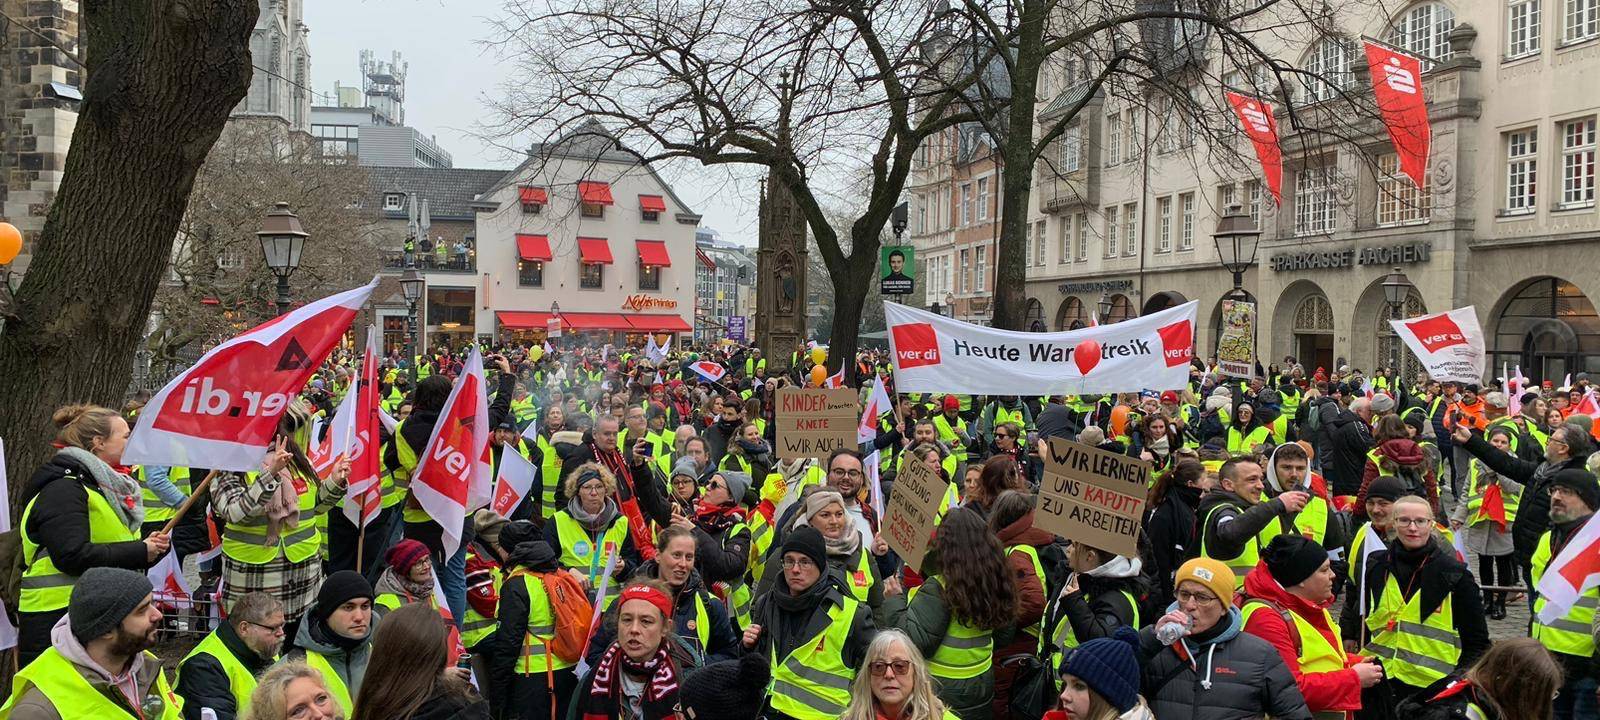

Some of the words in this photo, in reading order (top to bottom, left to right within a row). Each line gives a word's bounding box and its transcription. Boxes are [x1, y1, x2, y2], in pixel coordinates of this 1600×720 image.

[1270, 249, 1351, 272] SPARKASSE
[1359, 243, 1427, 266] AACHEN
[898, 348, 937, 360] ver.di
[953, 339, 1020, 362] Heute
[1029, 339, 1151, 362] Wartreik
[782, 393, 827, 412] KINDER
[796, 418, 829, 430] KNETE
[783, 436, 811, 454] WIR
[814, 437, 844, 452] AUCH
[909, 460, 930, 483] GUTE
[1049, 441, 1089, 472] WIR
[1092, 454, 1147, 485] LERNEN
[898, 465, 931, 504] BILDUNG
[1054, 477, 1081, 497] UNS
[1084, 485, 1141, 515] KAPUTT
[1042, 497, 1064, 516] ZU
[1069, 505, 1138, 538] ARBEITEN
